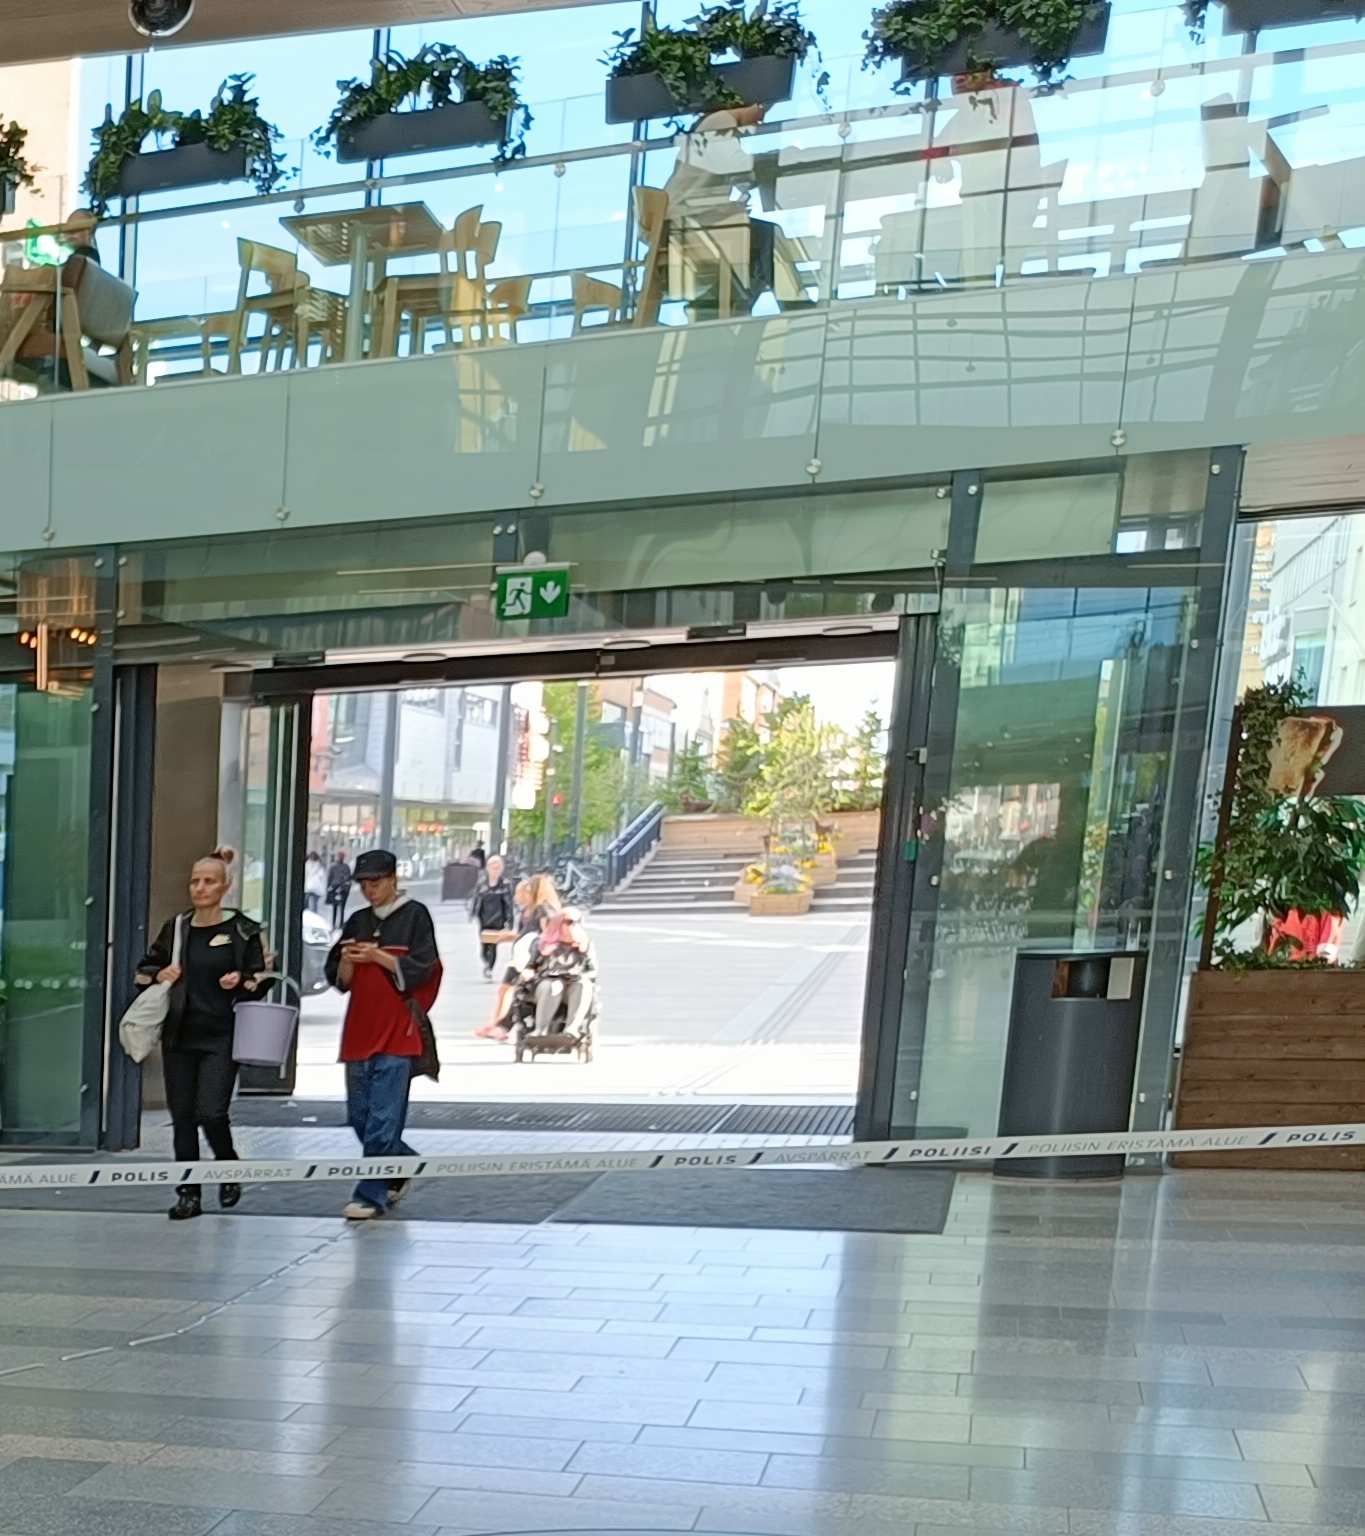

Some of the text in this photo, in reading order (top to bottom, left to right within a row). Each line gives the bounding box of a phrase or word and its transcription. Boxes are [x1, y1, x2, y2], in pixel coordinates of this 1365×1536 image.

[39, 1172, 77, 1185] ALUE
[111, 1171, 169, 1183] POLIS
[203, 1166, 293, 1180] AVSPÄRRAT
[328, 1165, 402, 1177] POLIISI
[436, 1161, 503, 1174] POLIISIN
[509, 1157, 594, 1172] ERISTÄMÄ
[598, 1157, 638, 1169] ALUE
[675, 1155, 737, 1166] POLIS
[774, 1149, 873, 1163] AVSPÄRRAT
[909, 1145, 991, 1158] POLIISI
[1028, 1141, 1101, 1153] POLIISIN
[1107, 1136, 1196, 1150] ERISTÄMÄ
[1204, 1135, 1250, 1146] ALUE
[1287, 1130, 1356, 1142] POLIS
